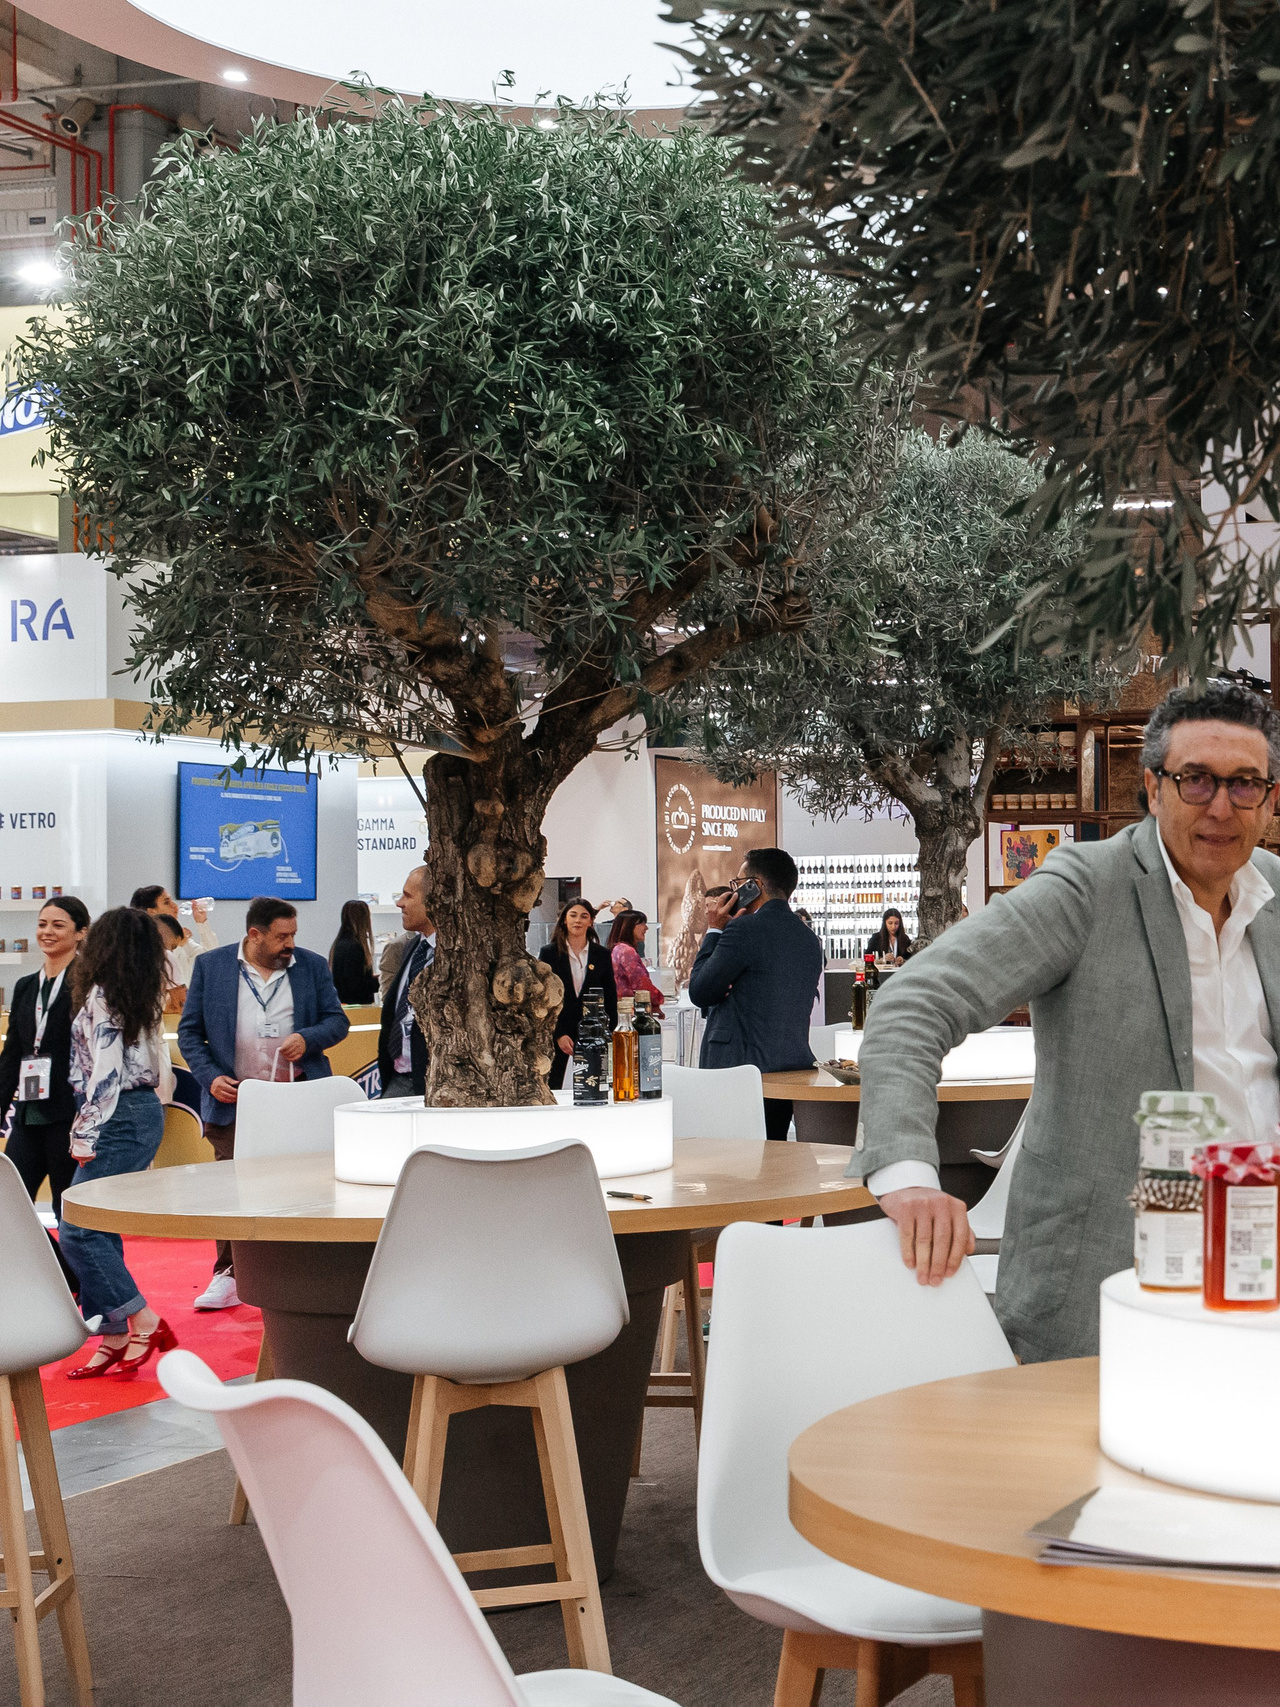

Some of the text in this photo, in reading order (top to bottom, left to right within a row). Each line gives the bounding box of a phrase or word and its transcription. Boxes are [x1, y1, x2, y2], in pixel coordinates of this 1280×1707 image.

[10, 812, 56, 829] VETRO
[701, 804, 767, 823] PRODUCED IN ITALY
[357, 818, 395, 831] GAMMA
[702, 822, 738, 838] SINCE 1986
[357, 837, 417, 851] STANDARD
